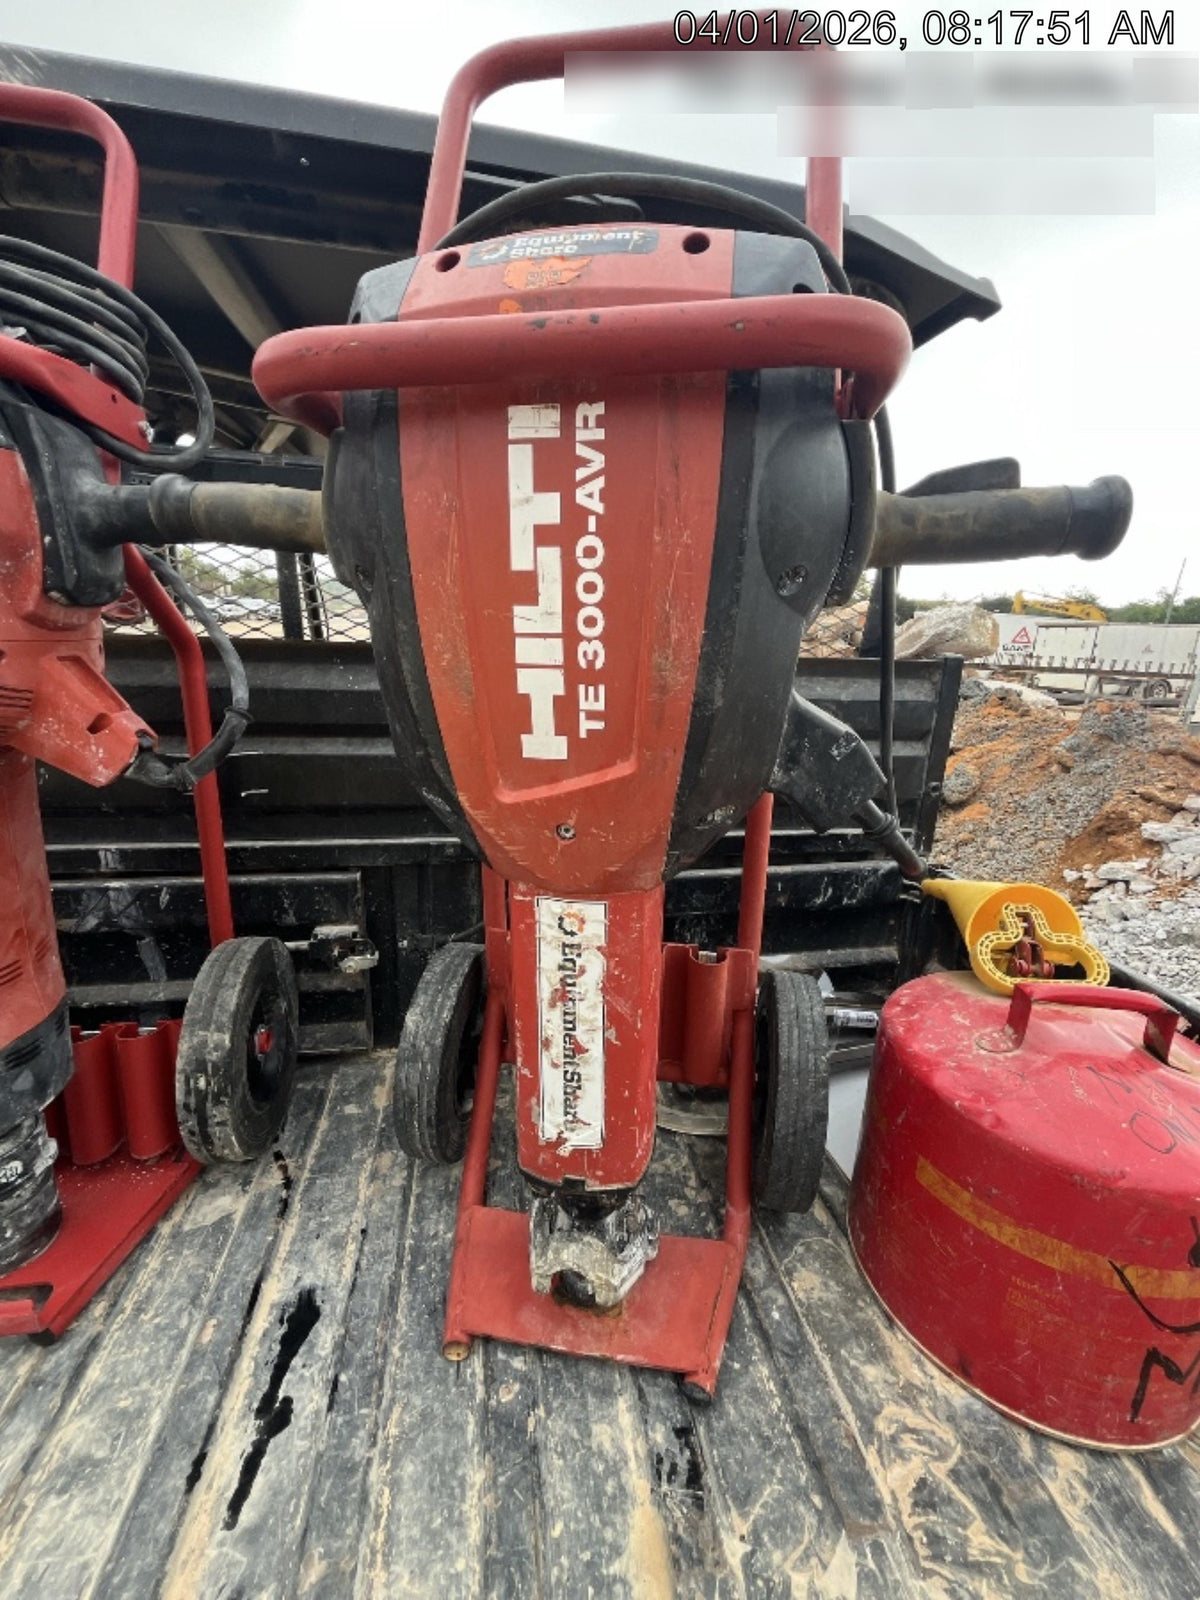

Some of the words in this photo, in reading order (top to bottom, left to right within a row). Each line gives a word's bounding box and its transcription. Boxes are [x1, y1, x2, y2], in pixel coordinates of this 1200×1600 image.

[509, 244, 578, 259] Share
[507, 403, 568, 760] HILTI
[575, 400, 606, 671] 3000-AVR
[578, 683, 606, 738] TE
